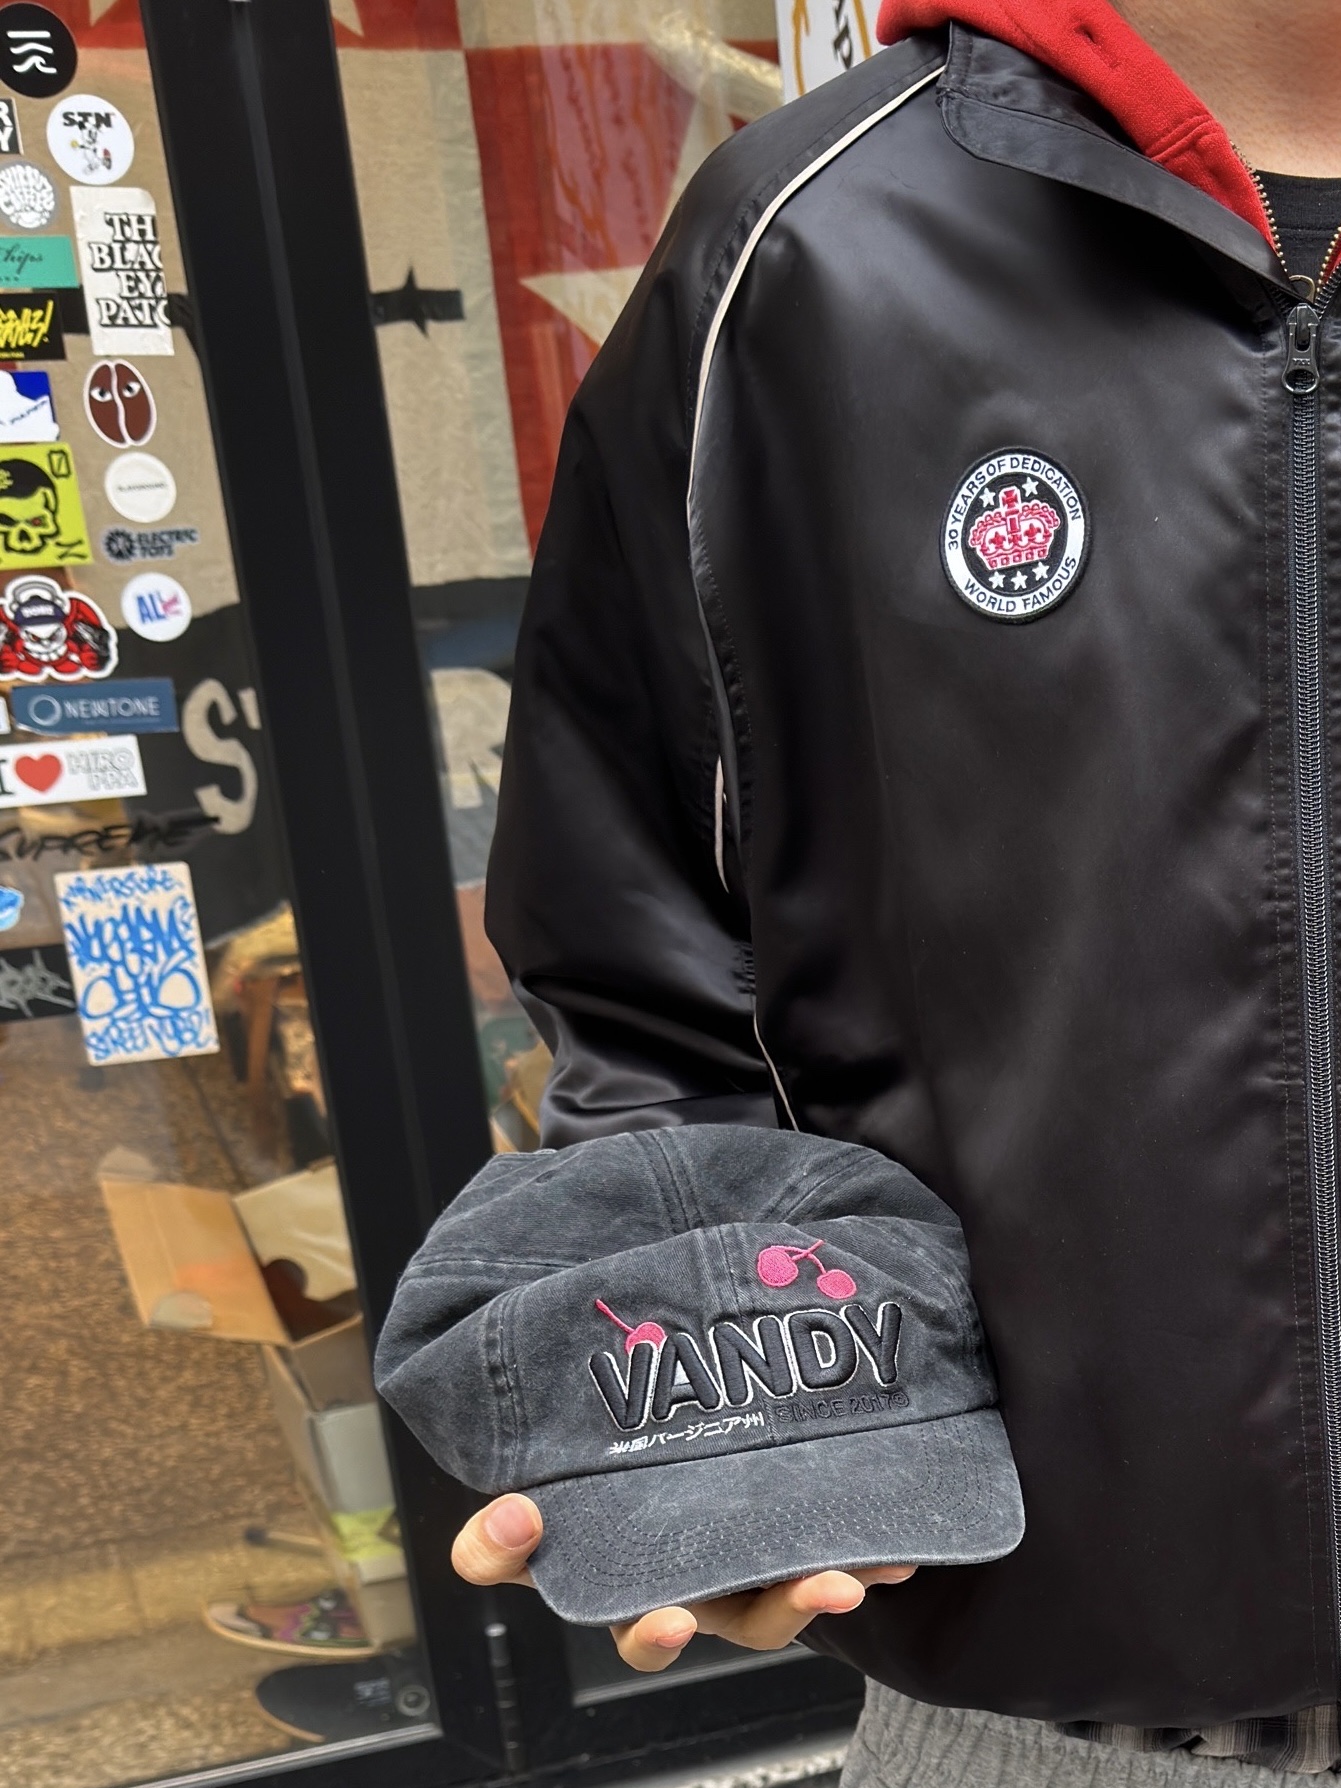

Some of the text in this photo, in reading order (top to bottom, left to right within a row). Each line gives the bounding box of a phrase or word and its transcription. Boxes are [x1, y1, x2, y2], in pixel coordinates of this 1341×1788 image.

[947, 456, 1081, 551] 30 YEARS OF DEDICATION
[964, 556, 1077, 613] WORLD FAMOUS
[64, 696, 161, 719] NEWTONE
[588, 1302, 903, 1432] VANDY
[776, 1398, 847, 1424] SINCE
